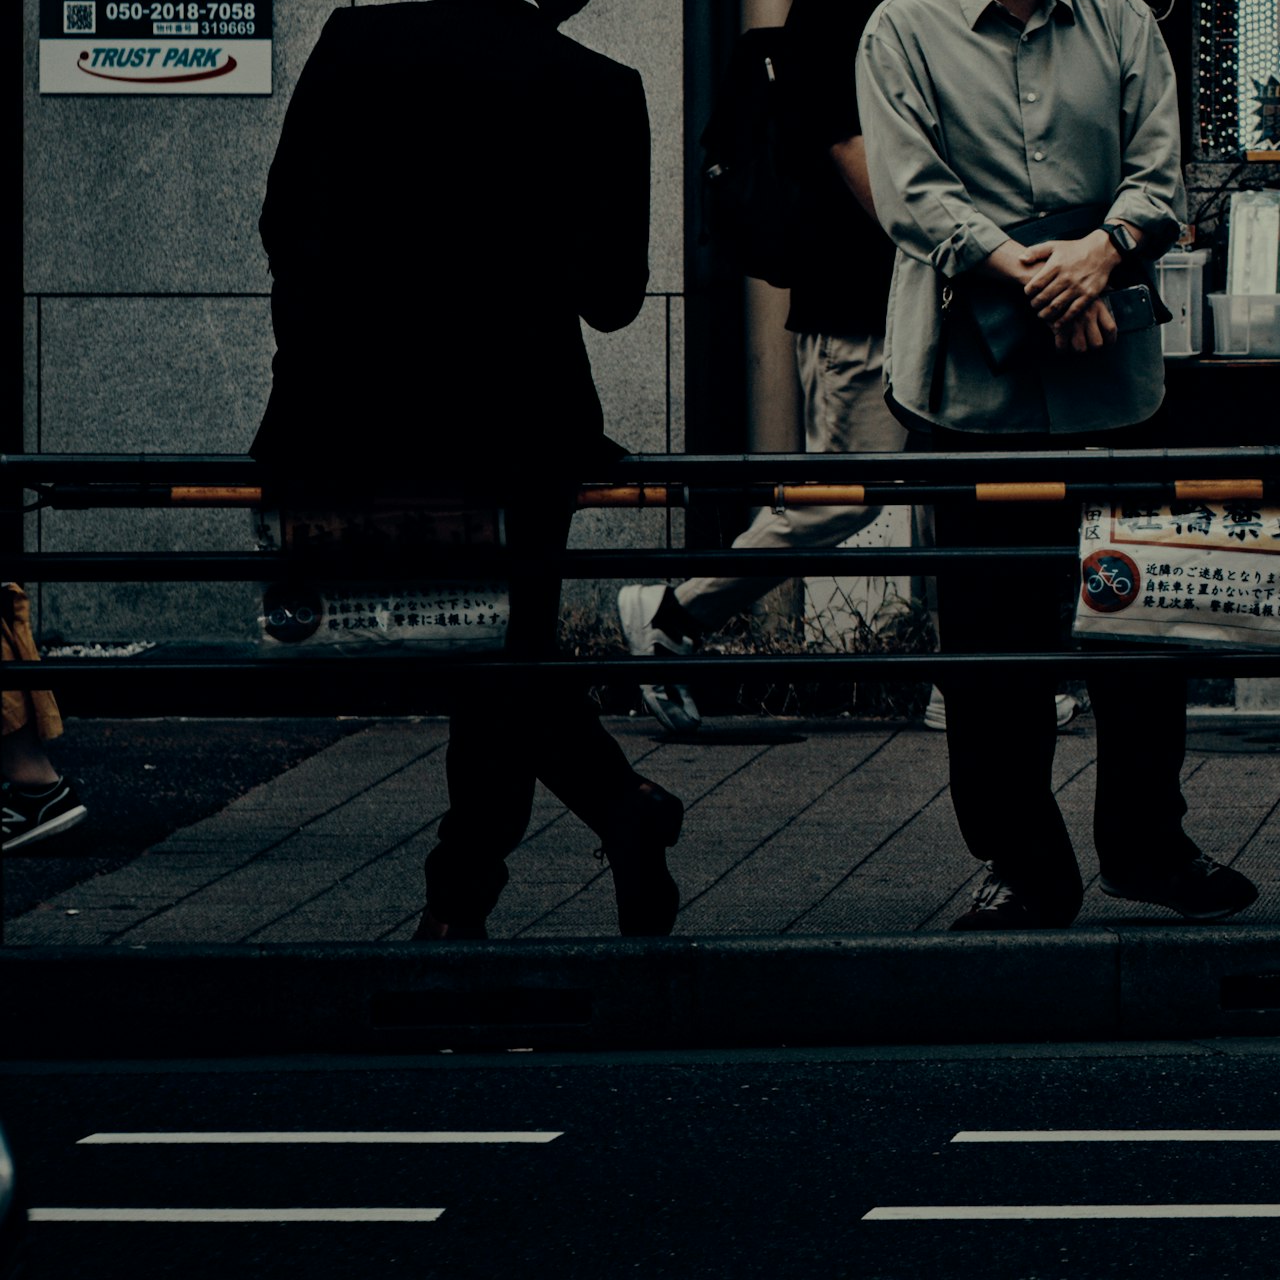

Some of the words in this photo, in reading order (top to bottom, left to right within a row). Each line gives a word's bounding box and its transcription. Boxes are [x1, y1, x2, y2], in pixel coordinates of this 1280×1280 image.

[105, 2, 256, 21] 050-2018-7058
[201, 21, 256, 36] 319669
[91, 47, 161, 67] TRUST
[162, 47, 222, 67] PARK
